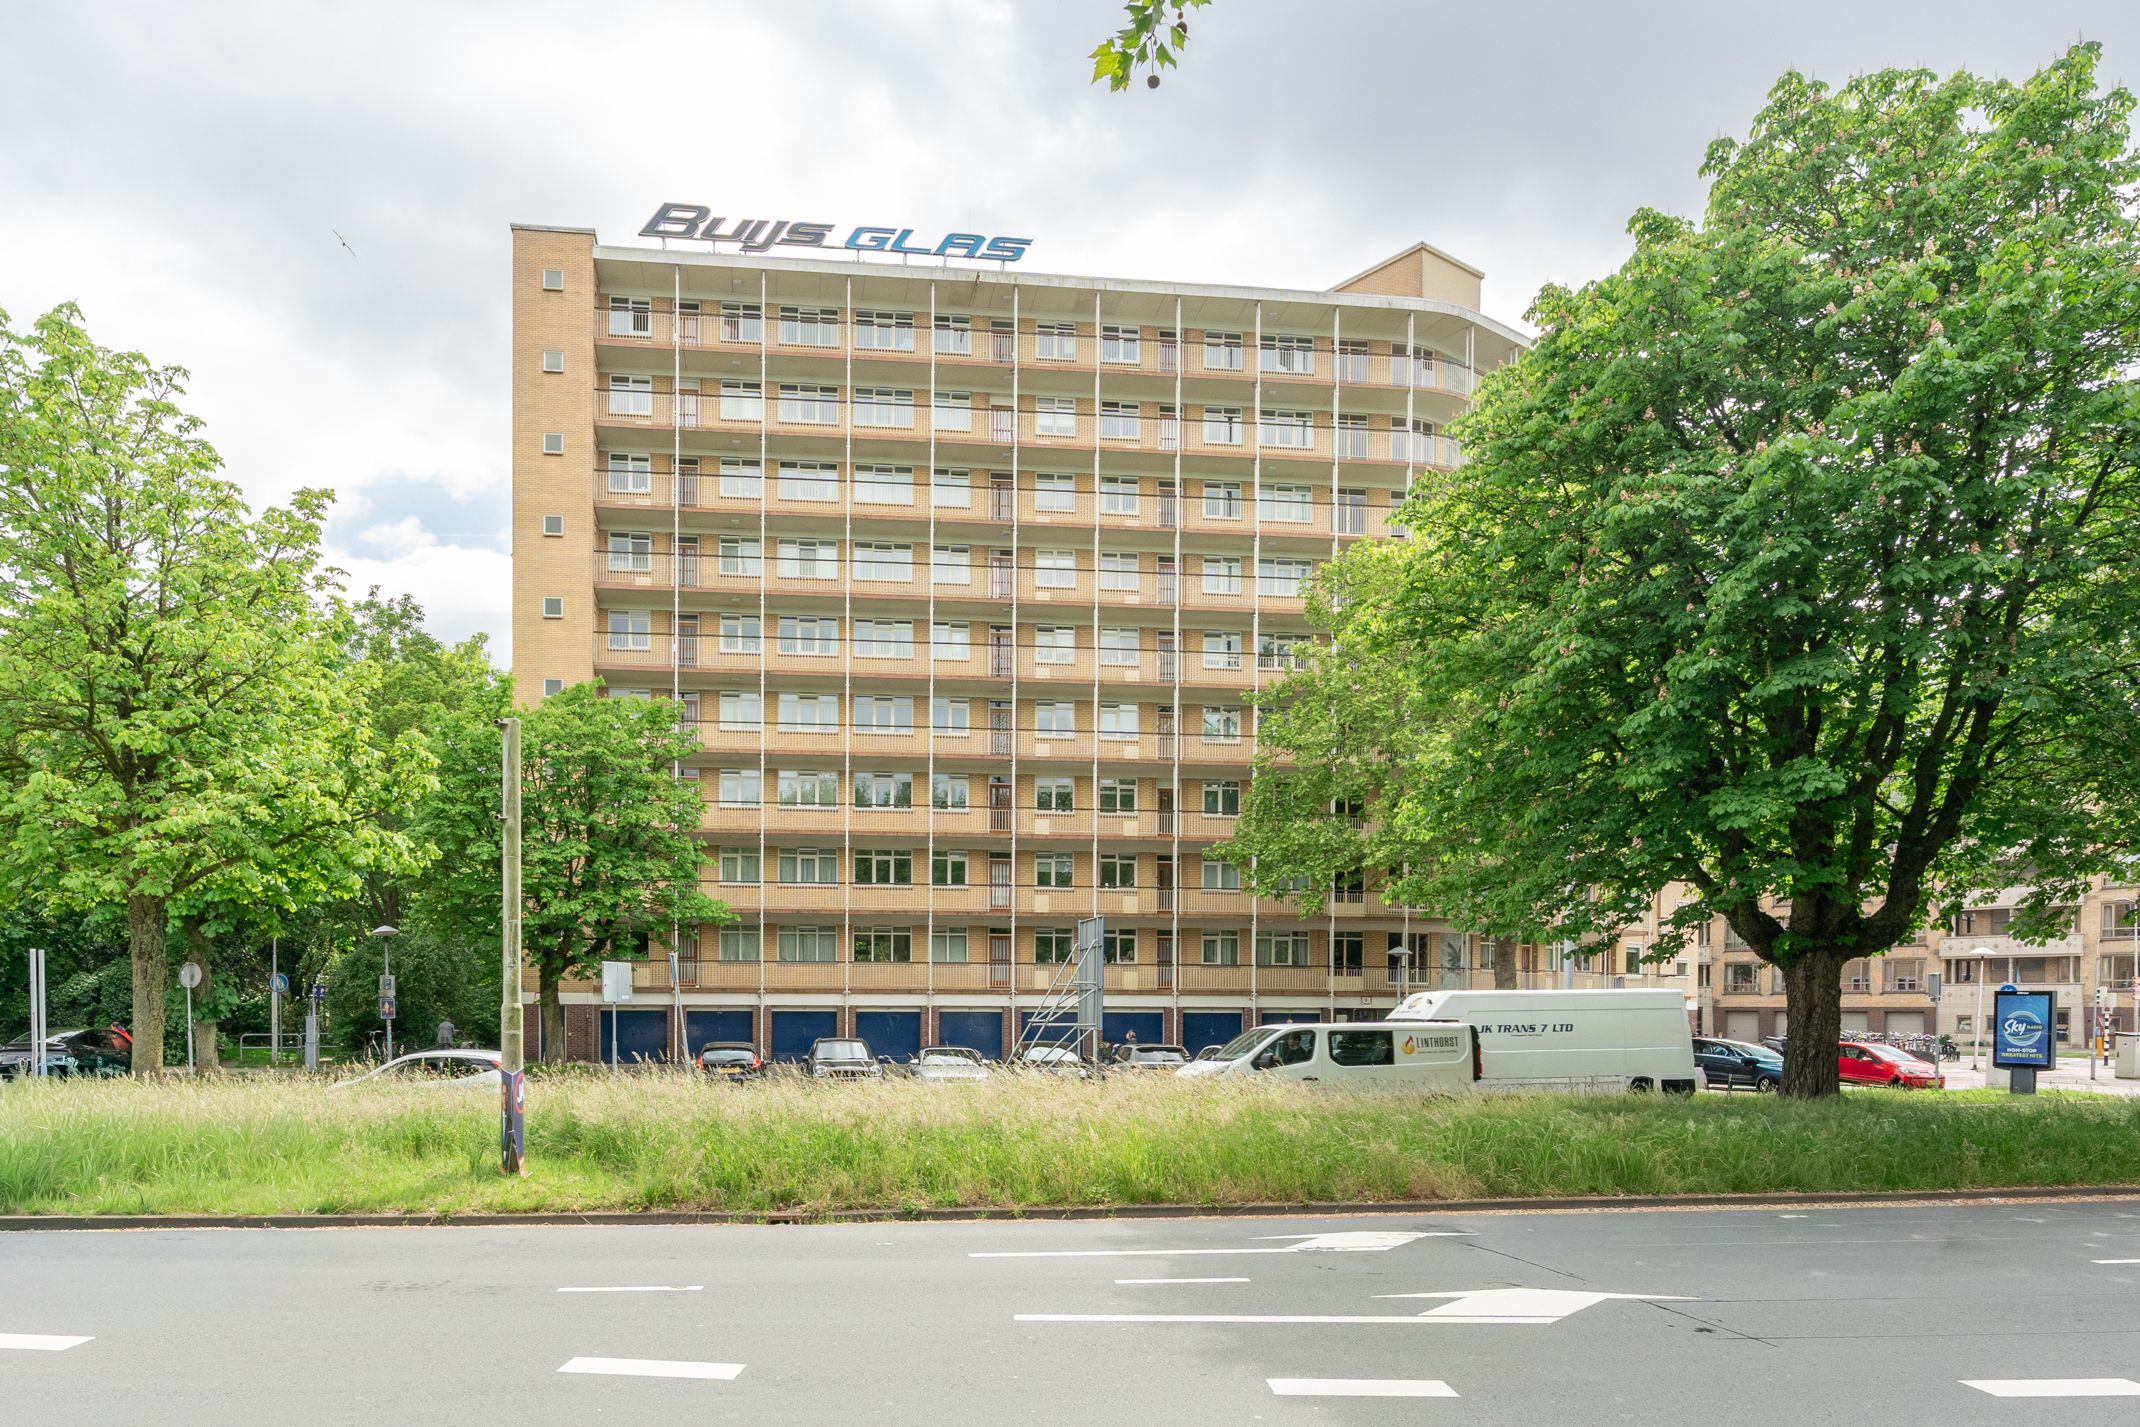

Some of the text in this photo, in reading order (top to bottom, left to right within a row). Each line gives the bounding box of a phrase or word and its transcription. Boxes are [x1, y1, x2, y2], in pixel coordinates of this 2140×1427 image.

[845, 226, 1033, 261] GLAS
[1496, 1024, 1537, 1033] TRANS
[1540, 1024, 1548, 1033] 7
[1552, 1023, 1574, 1033] LTD
[2004, 1019, 2027, 1035] Sky
[1416, 1036, 1459, 1048] LINTHORST
